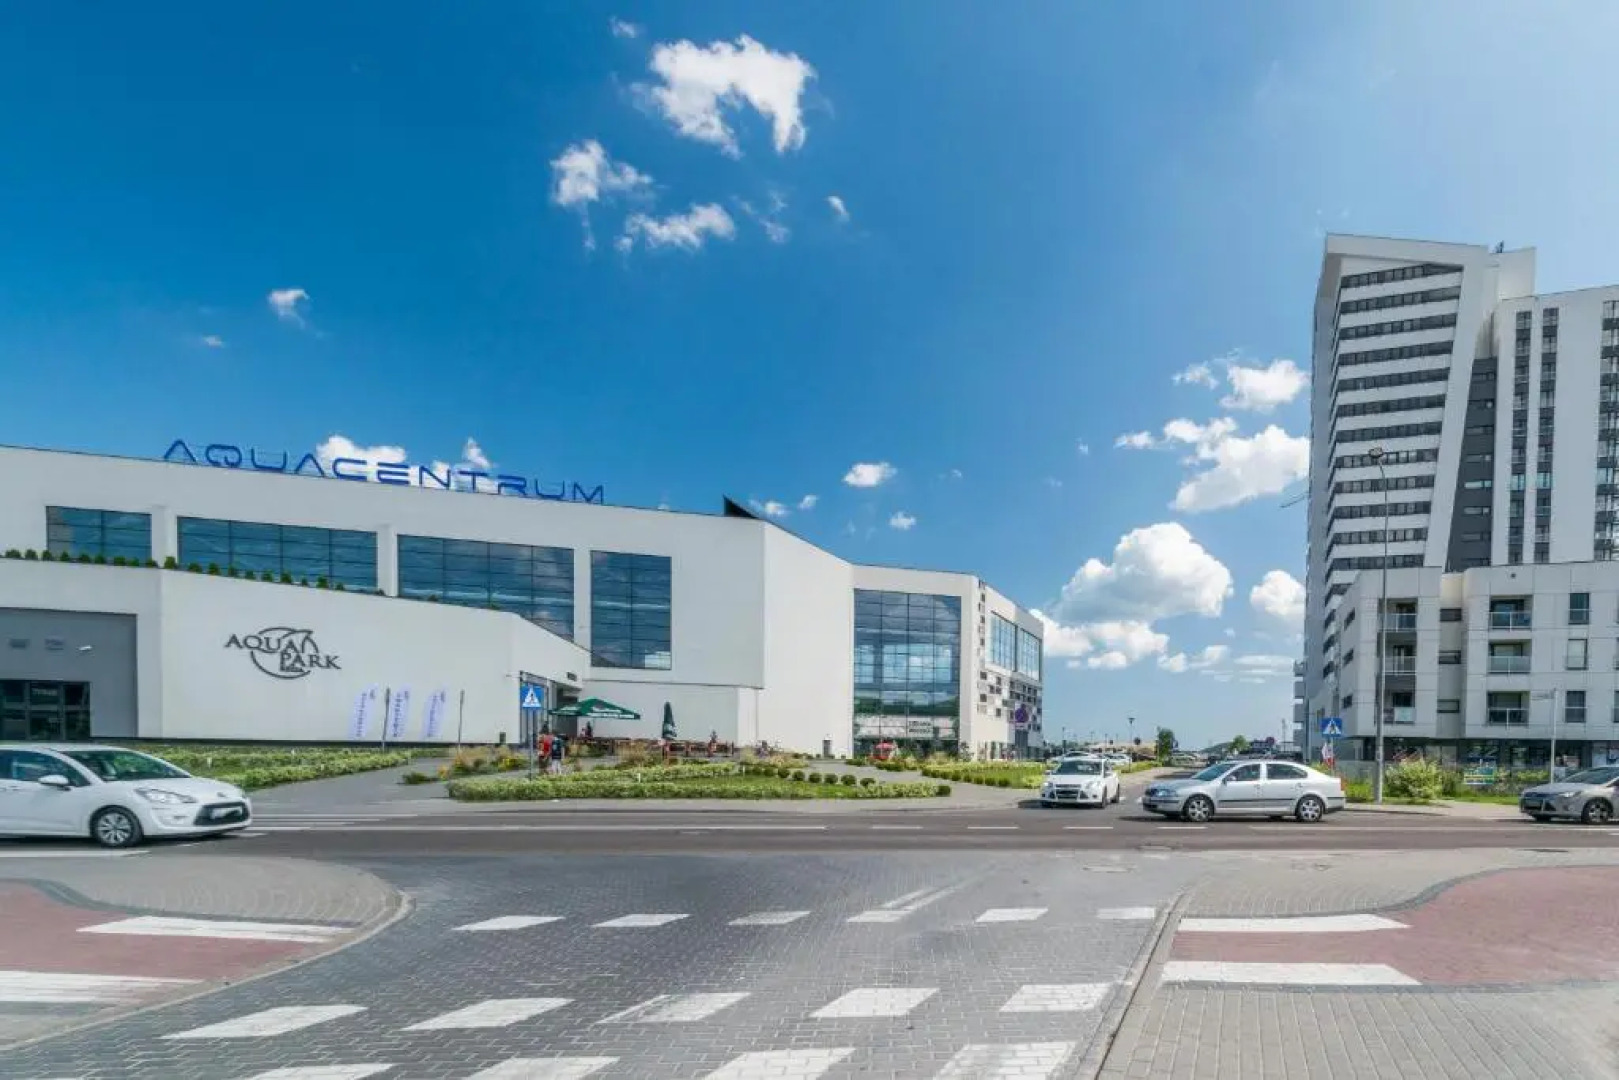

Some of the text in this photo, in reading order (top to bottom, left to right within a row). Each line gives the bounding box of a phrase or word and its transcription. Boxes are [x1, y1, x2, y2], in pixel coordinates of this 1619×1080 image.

[163, 439, 605, 504] AQUACENTRUM
[224, 633, 299, 653] AQUA
[280, 651, 342, 670] PARK
